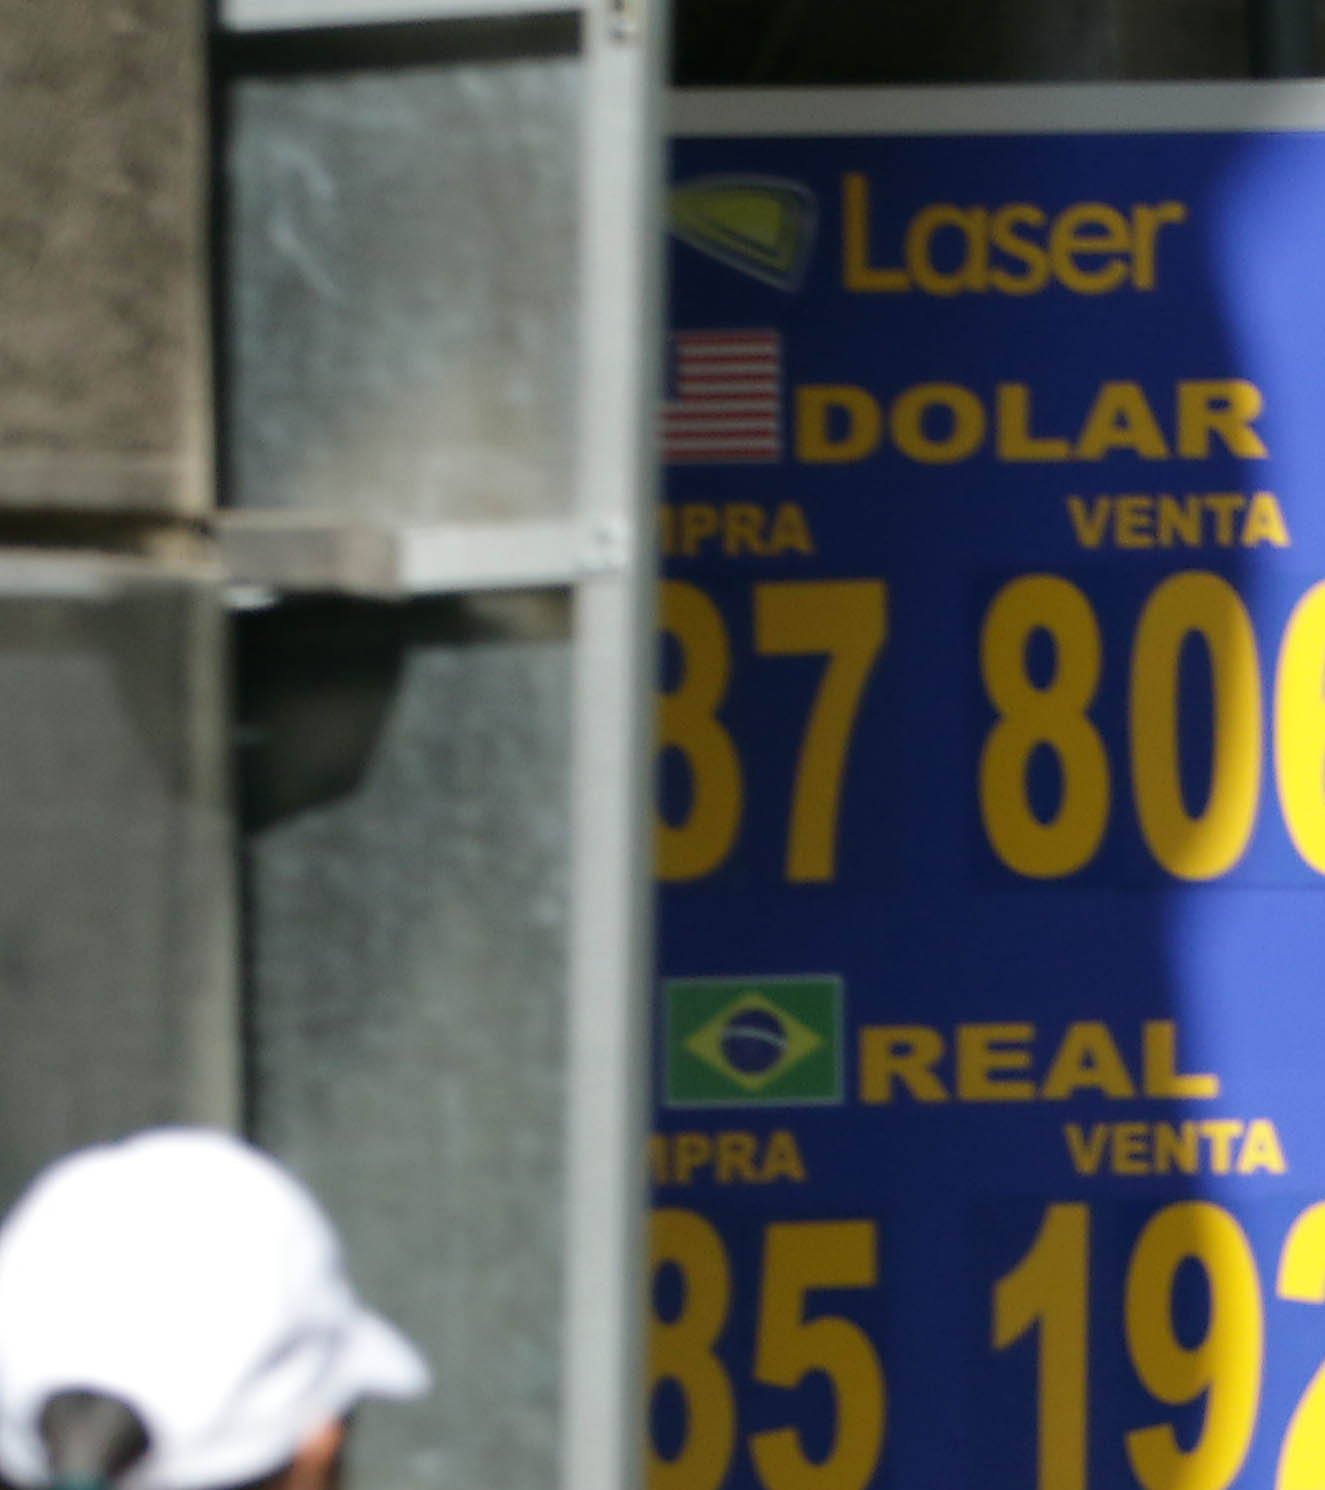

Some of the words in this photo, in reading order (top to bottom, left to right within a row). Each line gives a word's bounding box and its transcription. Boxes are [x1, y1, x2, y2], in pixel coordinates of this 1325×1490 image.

[841, 172, 1186, 295] Laser
[794, 378, 1268, 463] DOLAR
[1068, 492, 1291, 549] VENTA
[859, 1020, 1220, 1104] REAL
[1064, 1119, 1287, 1175] VENTA
